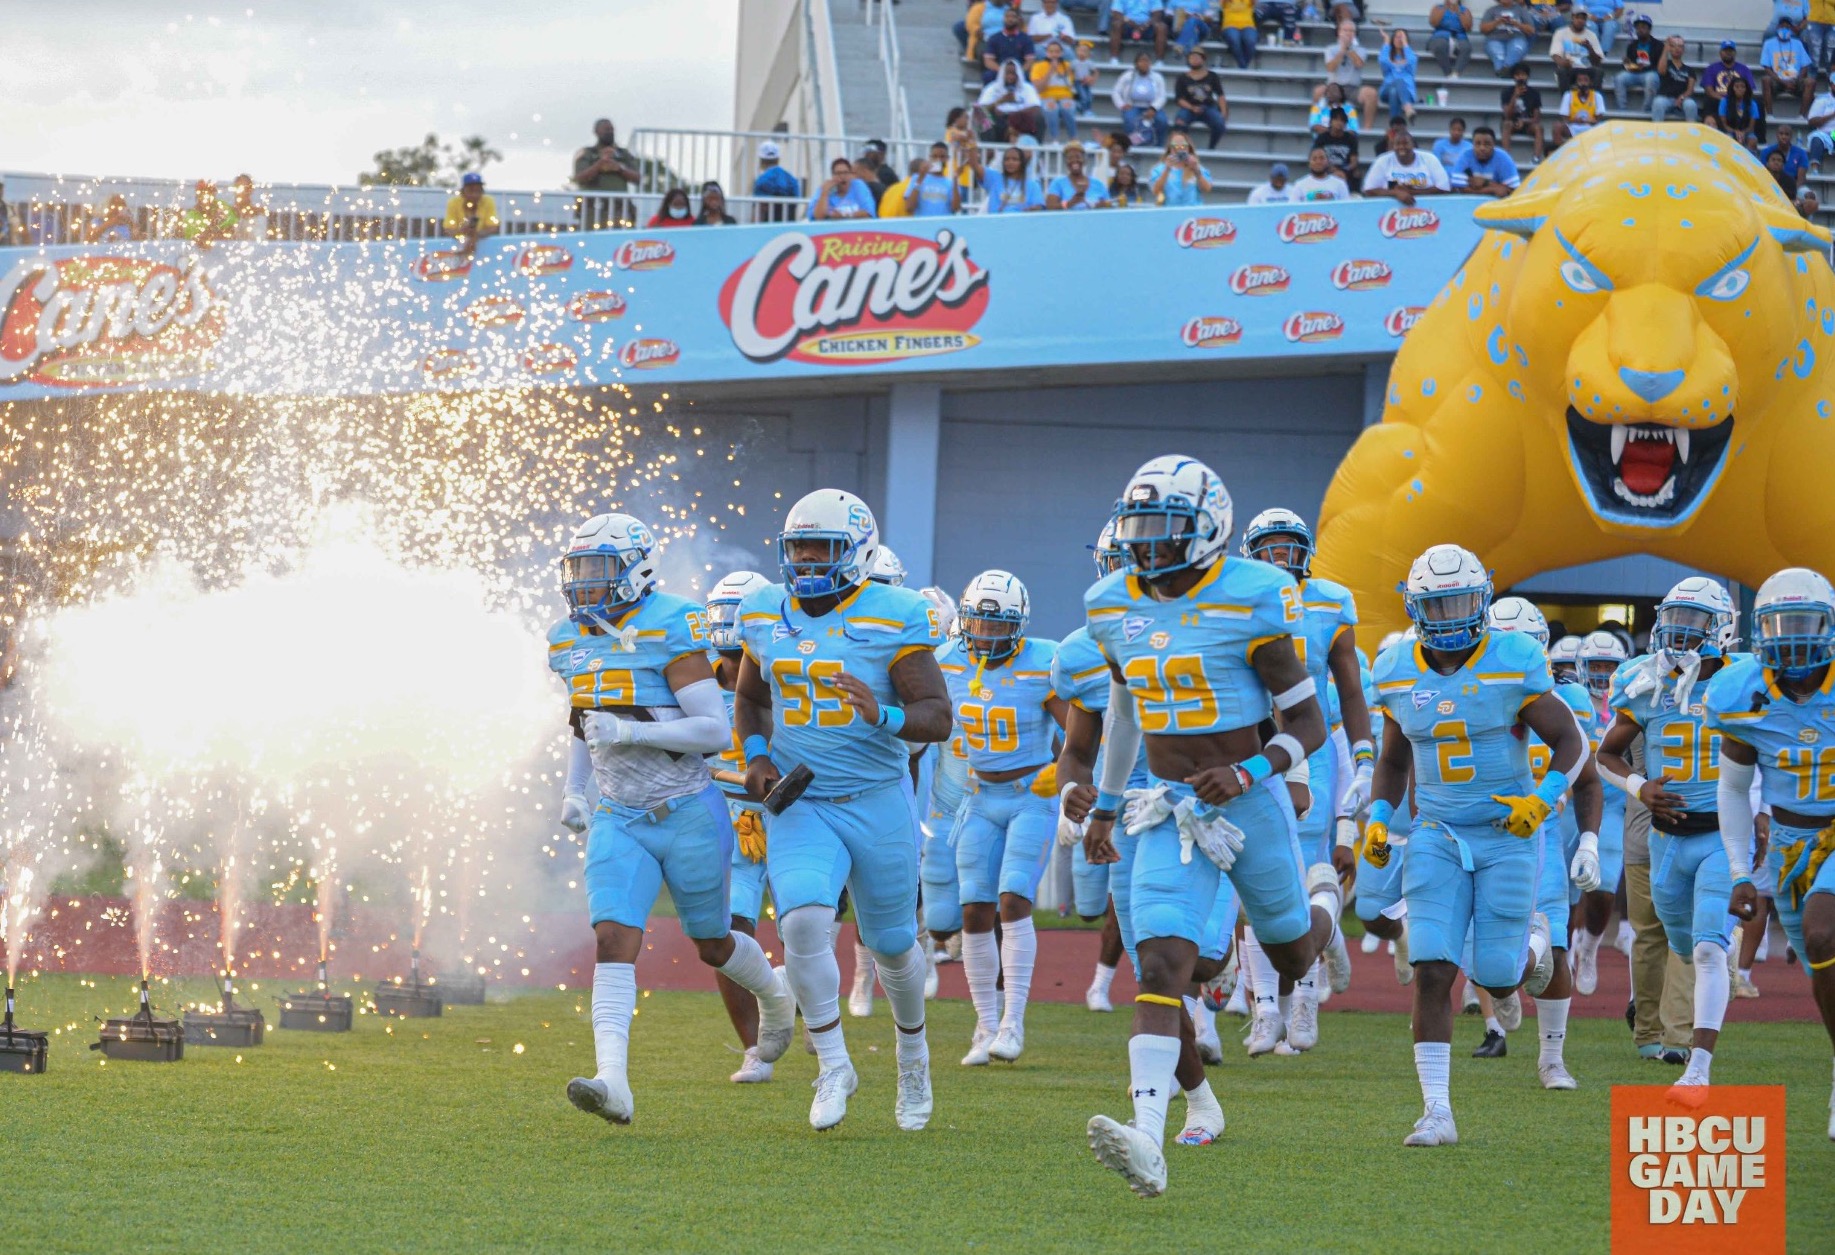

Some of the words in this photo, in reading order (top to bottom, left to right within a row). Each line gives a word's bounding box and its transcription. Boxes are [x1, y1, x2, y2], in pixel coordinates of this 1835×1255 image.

[820, 237, 910, 263] Raising
[0, 257, 213, 385] Cane's
[731, 229, 988, 364] Cane's
[818, 339, 888, 354] CHICKEN
[894, 335, 964, 351] FINGERS
[771, 658, 855, 727] 55
[1124, 654, 1220, 731] 29
[959, 702, 1019, 752] 20
[1431, 719, 1476, 784] 2
[1661, 721, 1722, 782] 30
